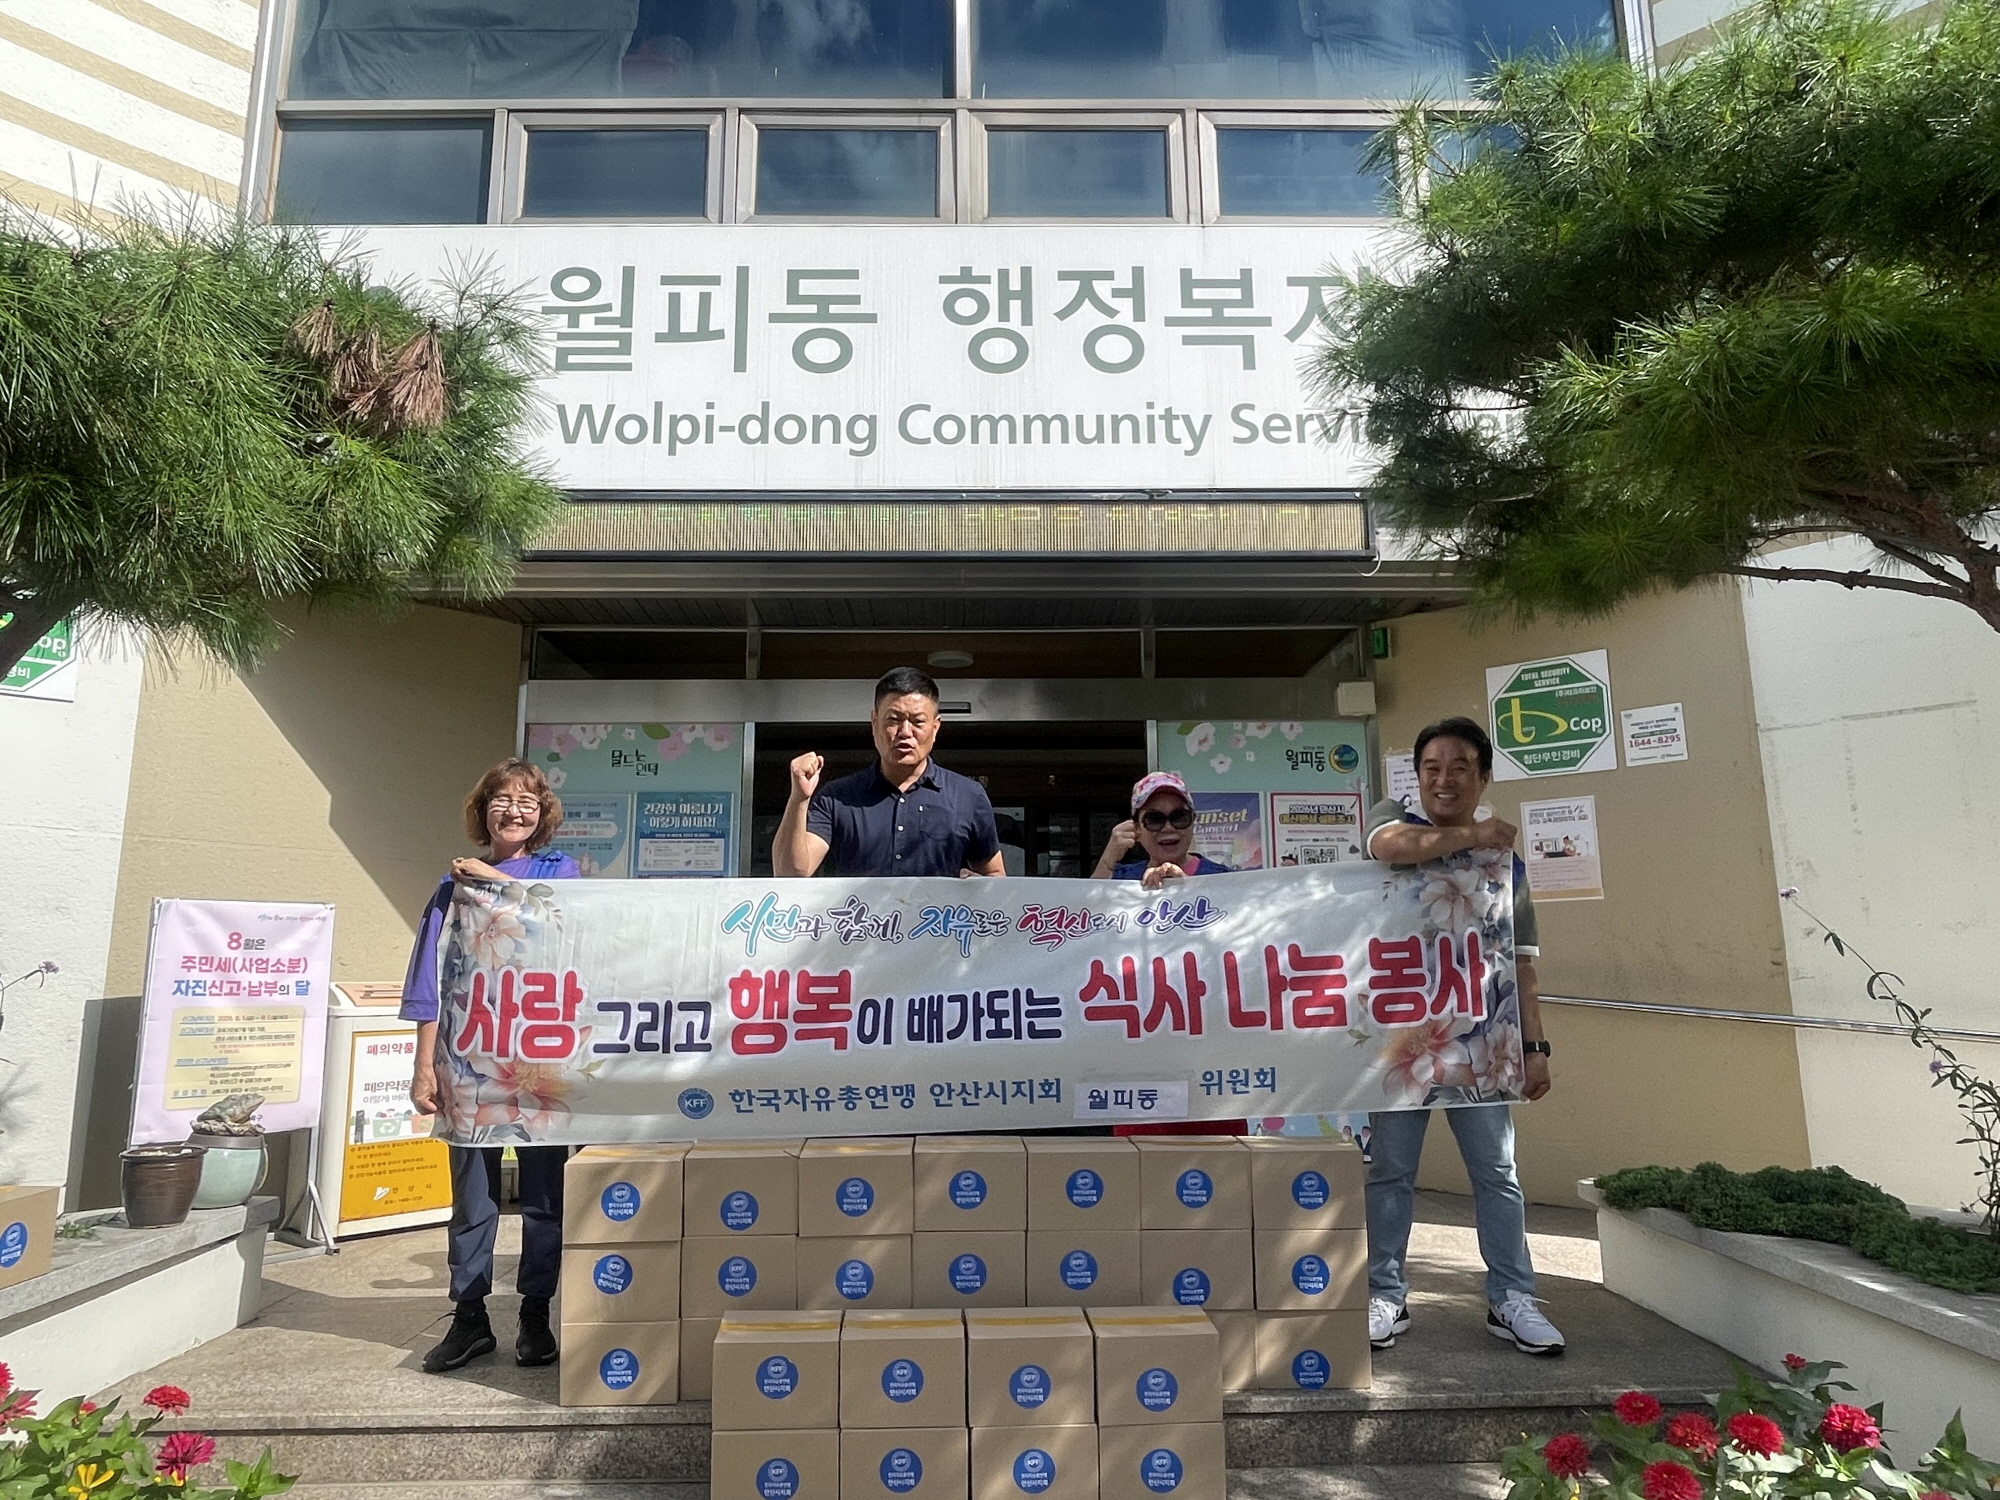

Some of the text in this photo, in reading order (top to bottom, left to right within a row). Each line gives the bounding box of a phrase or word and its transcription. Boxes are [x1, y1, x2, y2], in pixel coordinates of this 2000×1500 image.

[541, 265, 878, 374] 월피동
[557, 401, 878, 457] Wolpi-dong
[899, 401, 1211, 457] Community
[1521, 671, 1540, 681] TOTAL
[1569, 717, 1602, 733] Cop
[1629, 734, 1681, 748] 1644-8295
[1285, 749, 1327, 772] 월피동
[1194, 808, 1249, 825] unset
[721, 891, 831, 957] 시민과
[908, 903, 1011, 958] 자유로운
[1016, 903, 1129, 952] 혁신도시
[1135, 896, 1227, 934] 안산
[227, 931, 266, 950] 8월은
[181, 955, 308, 974] 주민세(사업소분)
[295, 980, 311, 996] 달
[456, 969, 584, 1060] 사랑
[592, 1000, 713, 1055] 그리고
[907, 989, 1063, 1046] 배가되는
[1079, 951, 1207, 1040] 식사
[1223, 943, 1349, 1031] 나눔
[1368, 929, 1487, 1025] 봉사
[366, 1042, 415, 1056] 폐의약품
[684, 1066, 1277, 1114] KFF 한국자유총연맹 안산시지회 월피동 위원회
